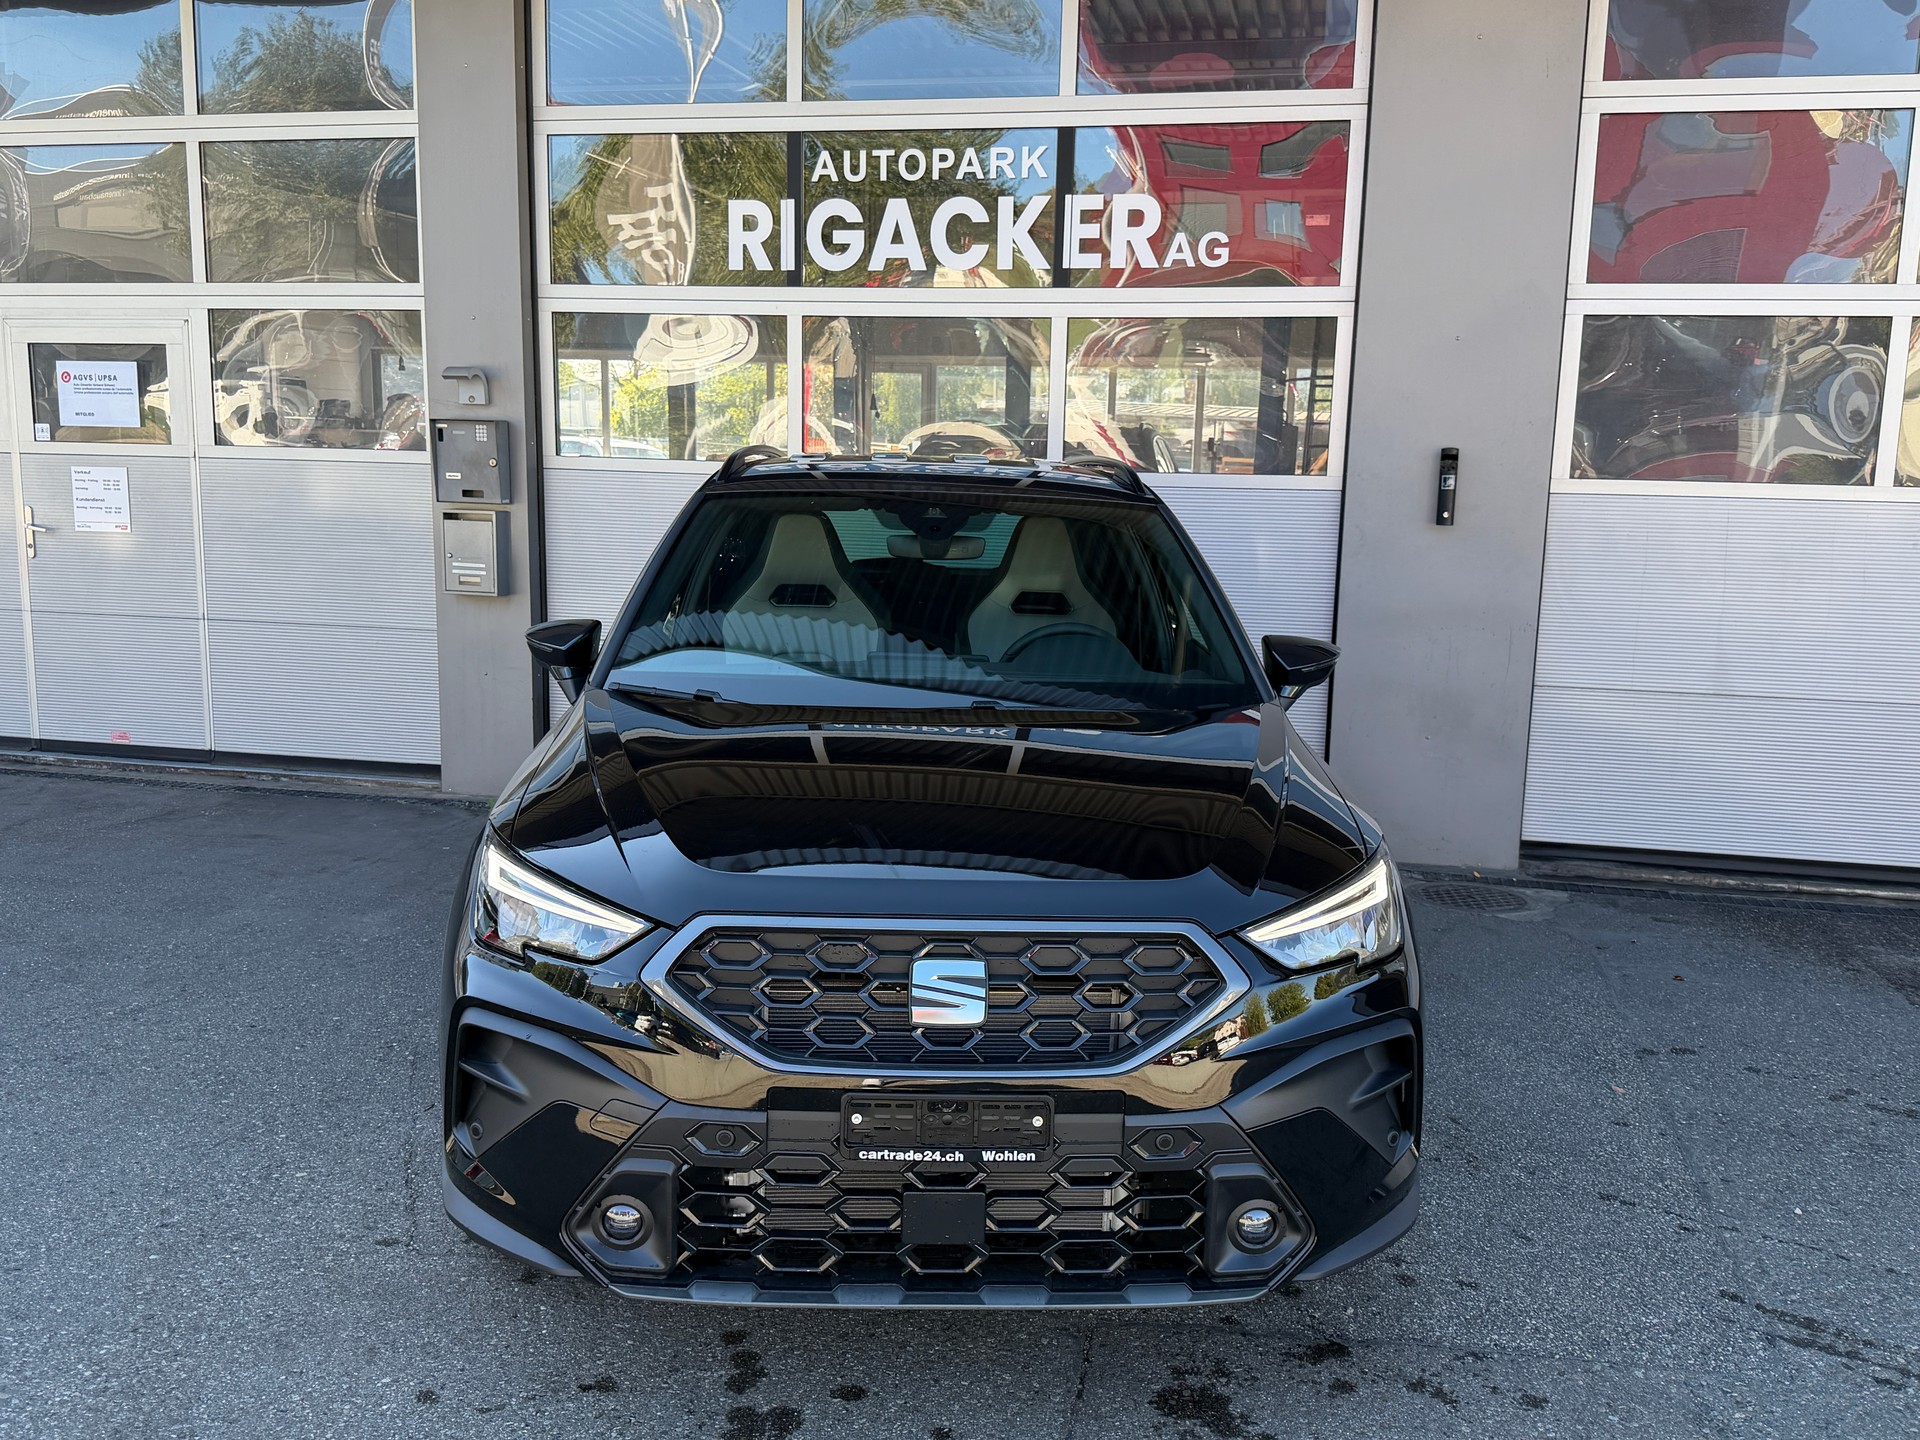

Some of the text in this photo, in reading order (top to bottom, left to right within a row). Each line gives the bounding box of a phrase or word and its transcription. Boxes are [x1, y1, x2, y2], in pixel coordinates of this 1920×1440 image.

[811, 145, 1049, 183] AUTOPARK
[728, 193, 1163, 272] RIGACKER
[1163, 231, 1230, 269] AG
[73, 374, 118, 382] AGVS UPSA
[858, 1149, 1036, 1162] cartrade24.ch Wohlen
